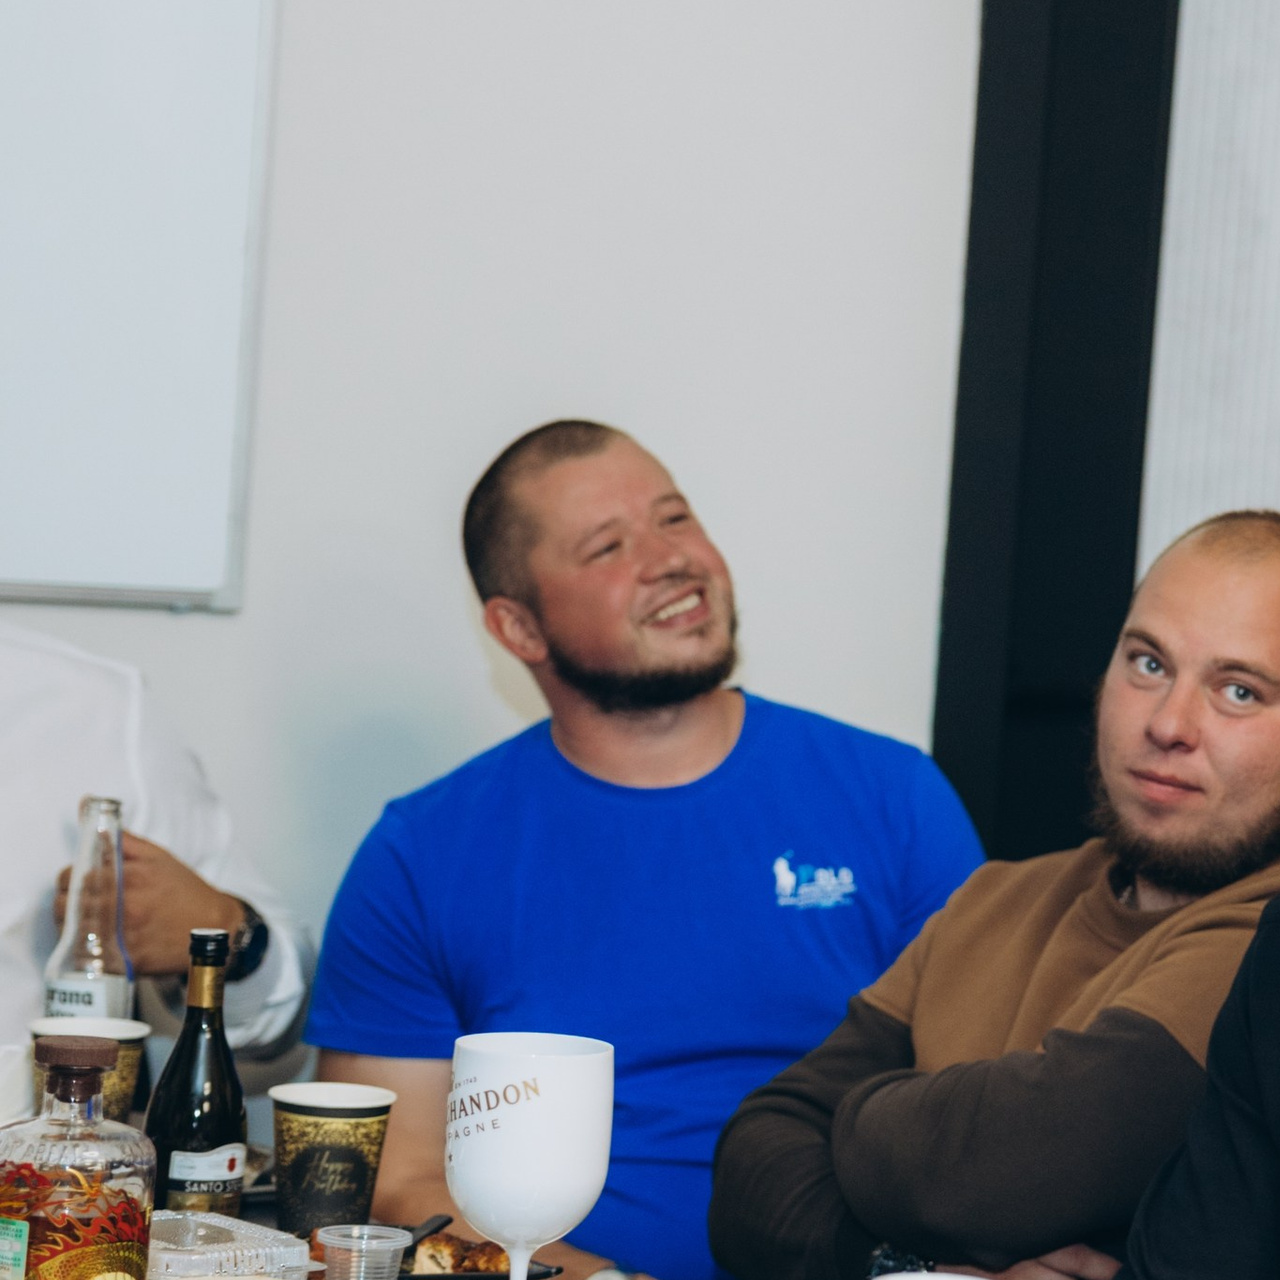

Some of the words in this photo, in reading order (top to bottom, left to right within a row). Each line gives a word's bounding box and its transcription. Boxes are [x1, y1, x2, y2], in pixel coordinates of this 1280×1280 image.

[46, 987, 93, 1006] rona
[448, 1118, 501, 1140] PAGNE
[184, 1180, 224, 1194] SANTO
